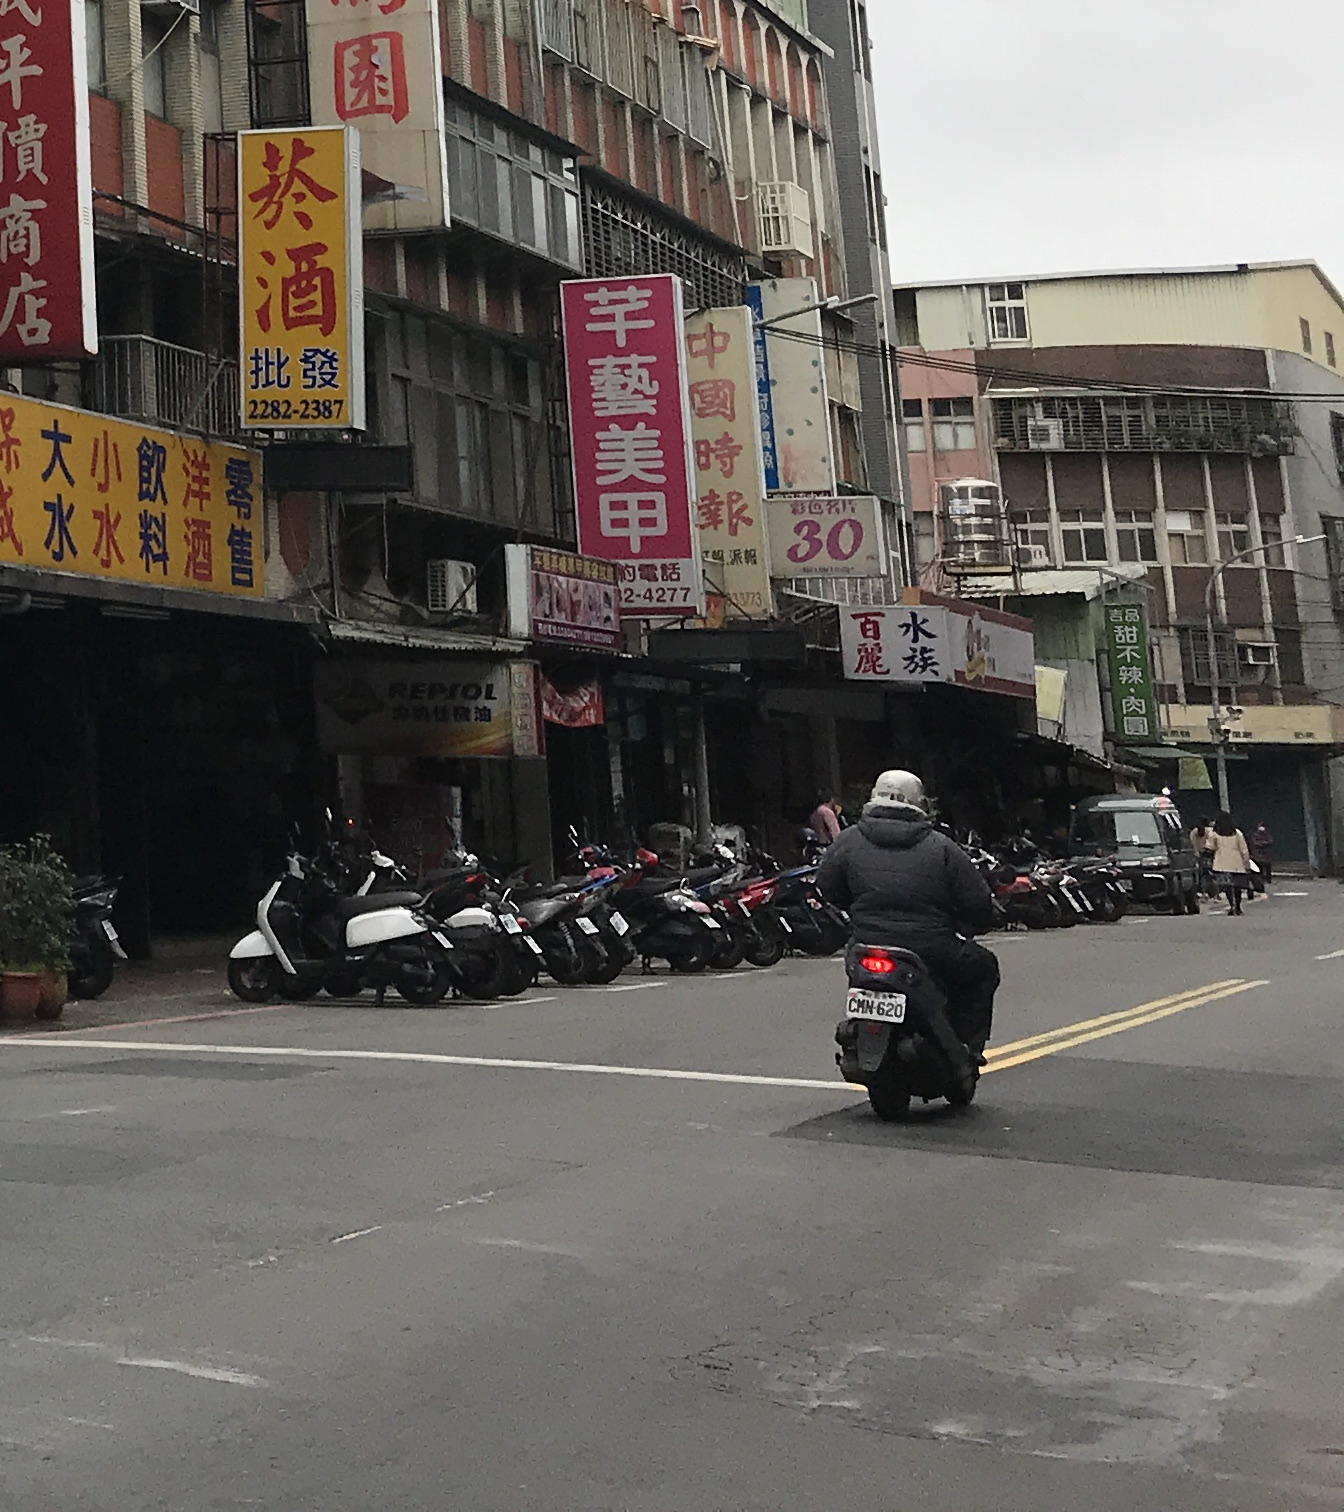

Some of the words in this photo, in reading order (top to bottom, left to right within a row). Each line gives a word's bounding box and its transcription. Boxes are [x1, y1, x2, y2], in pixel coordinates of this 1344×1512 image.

[248, 398, 345, 421] 2282-2387
[249, 346, 340, 390] 批發
[687, 323, 753, 536] 中國時報
[41, 420, 78, 562] 大水
[91, 430, 125, 569] 小水
[137, 437, 169, 576] 飲料
[182, 448, 213, 582] 洋酒
[225, 457, 255, 588] 零售
[787, 518, 864, 564] 30
[619, 587, 691, 604] 2-4277
[850, 611, 890, 676] 百麗
[898, 611, 940, 677] 水族
